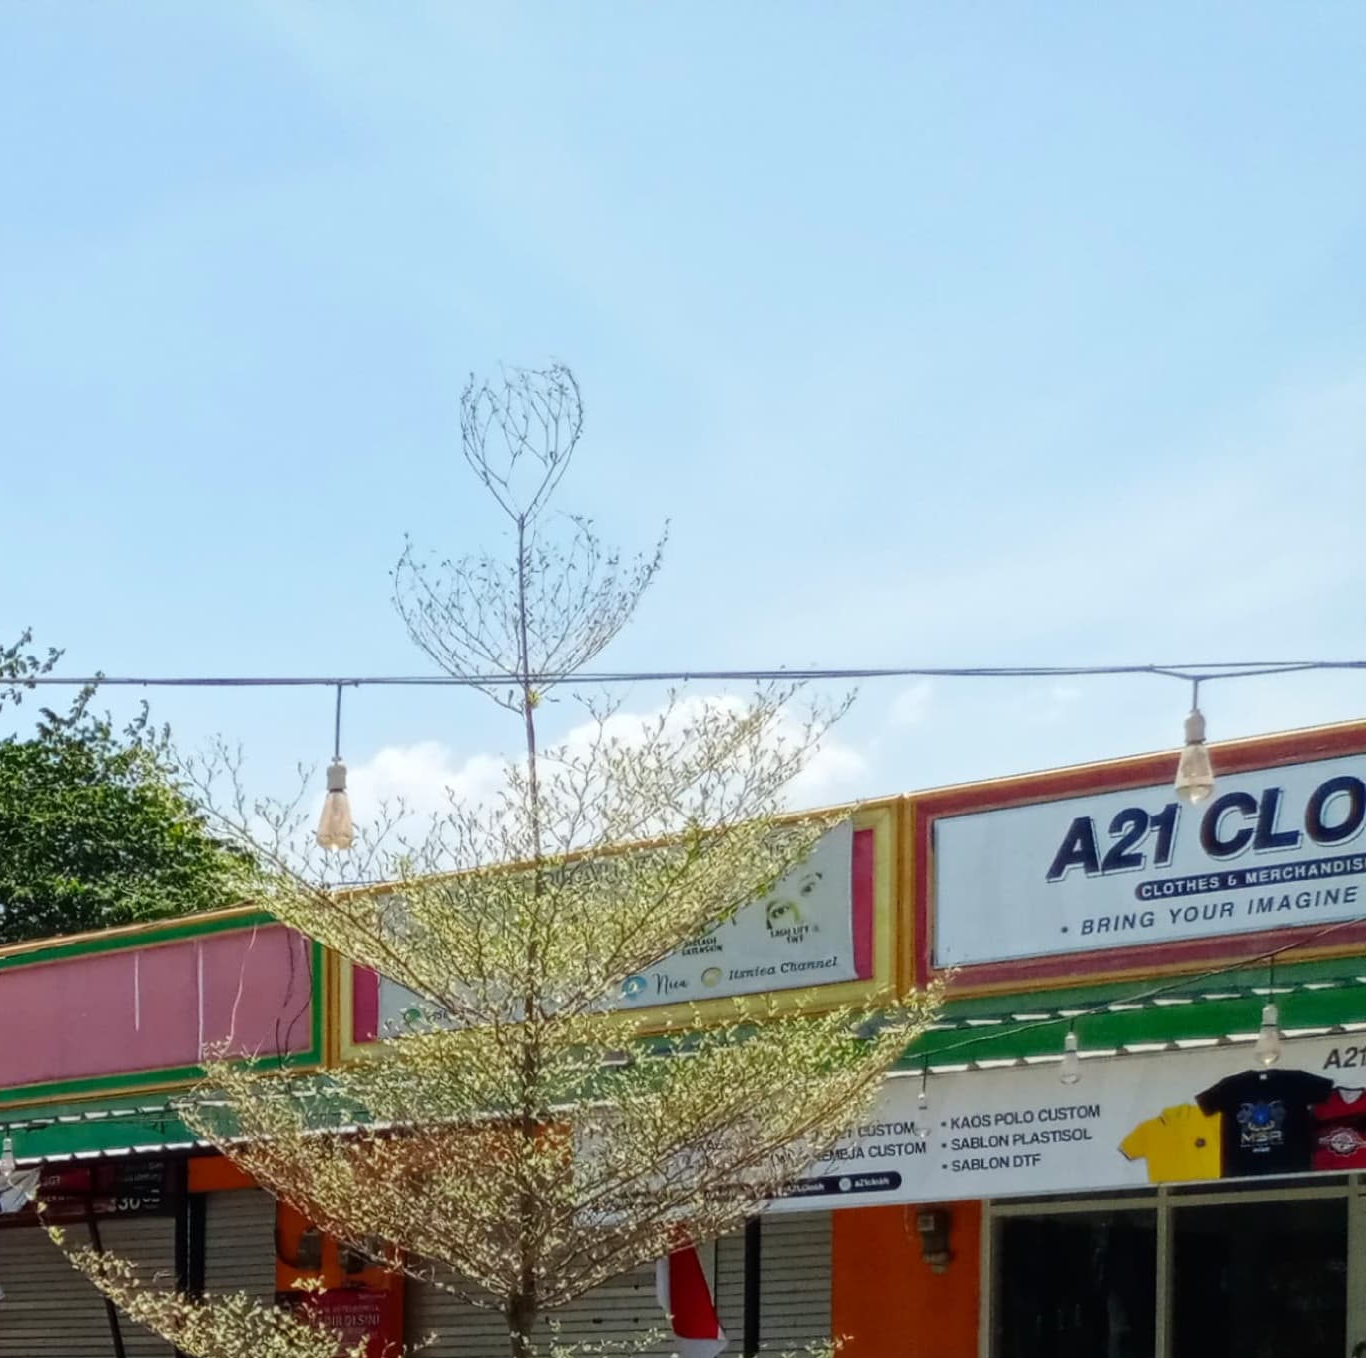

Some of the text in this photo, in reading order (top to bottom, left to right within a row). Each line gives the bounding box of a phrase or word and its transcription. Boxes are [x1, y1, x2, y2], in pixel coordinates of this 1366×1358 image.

[1046, 776, 1366, 883] A21 CLO
[1141, 856, 1366, 898] CLOTHES & MERCHANDIS
[1081, 886, 1359, 935] BRING YOUR IMAGINE
[780, 955, 838, 976] Channel
[951, 1104, 1101, 1130] KAOS POLO CUSTOM
[858, 1121, 915, 1138] CUSTOM
[951, 1128, 1092, 1150] SABLON PLASTISOL
[868, 1141, 927, 1158] CUSTOM
[951, 1153, 1041, 1172] SABLON DTF
